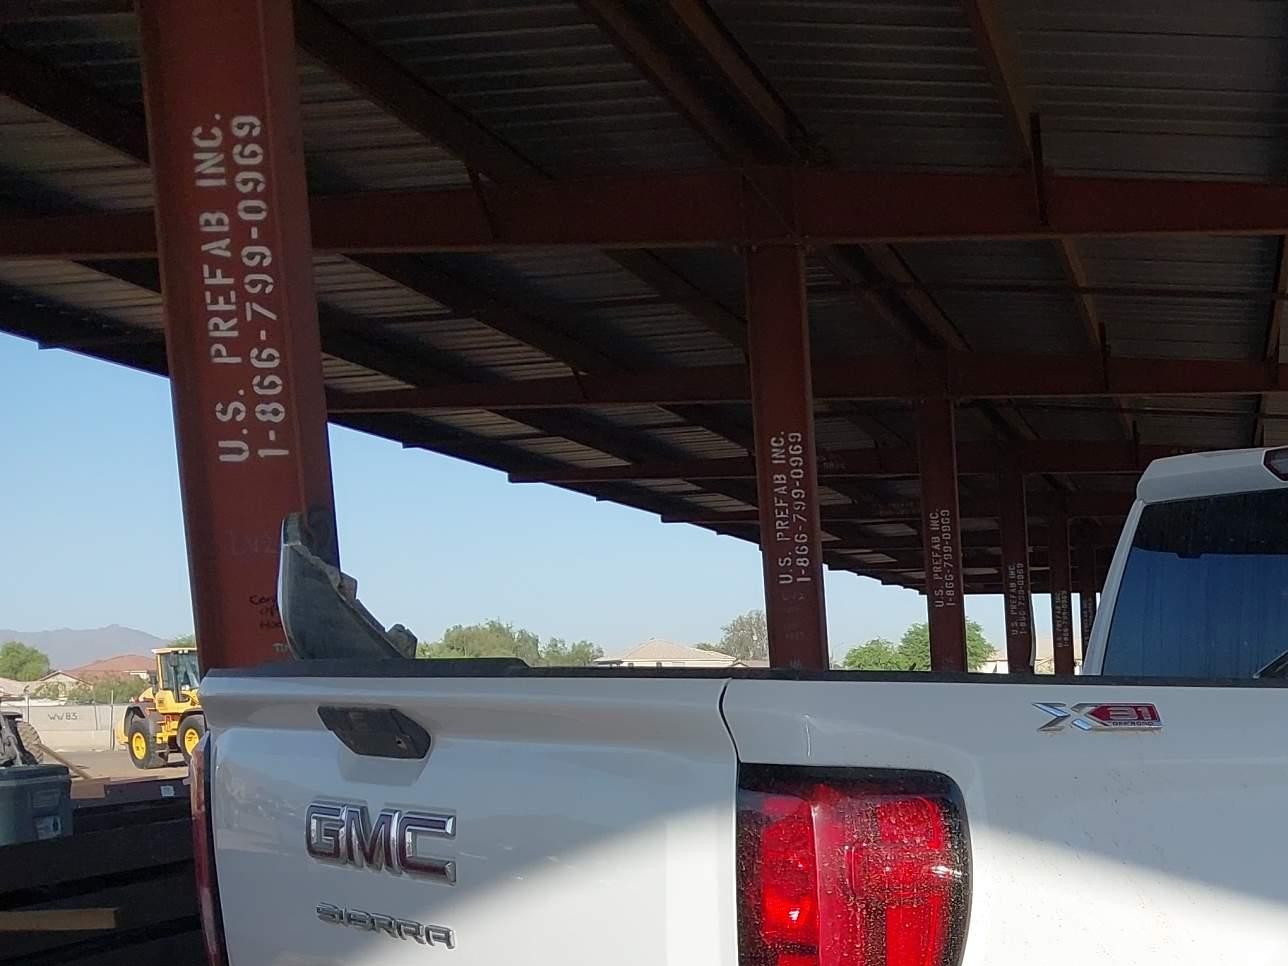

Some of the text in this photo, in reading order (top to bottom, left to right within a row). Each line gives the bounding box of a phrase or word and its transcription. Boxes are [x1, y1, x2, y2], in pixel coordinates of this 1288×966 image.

[192, 114, 250, 462] U.S. PREFAB INC.
[232, 115, 290, 458] 1-866-799-0969
[770, 431, 793, 584] U.S. PREFAB INC.
[788, 432, 812, 582] 1-866-799-0969
[931, 536, 943, 580] PREFAB
[305, 800, 457, 887] GMC
[316, 902, 456, 949] SIERRA
